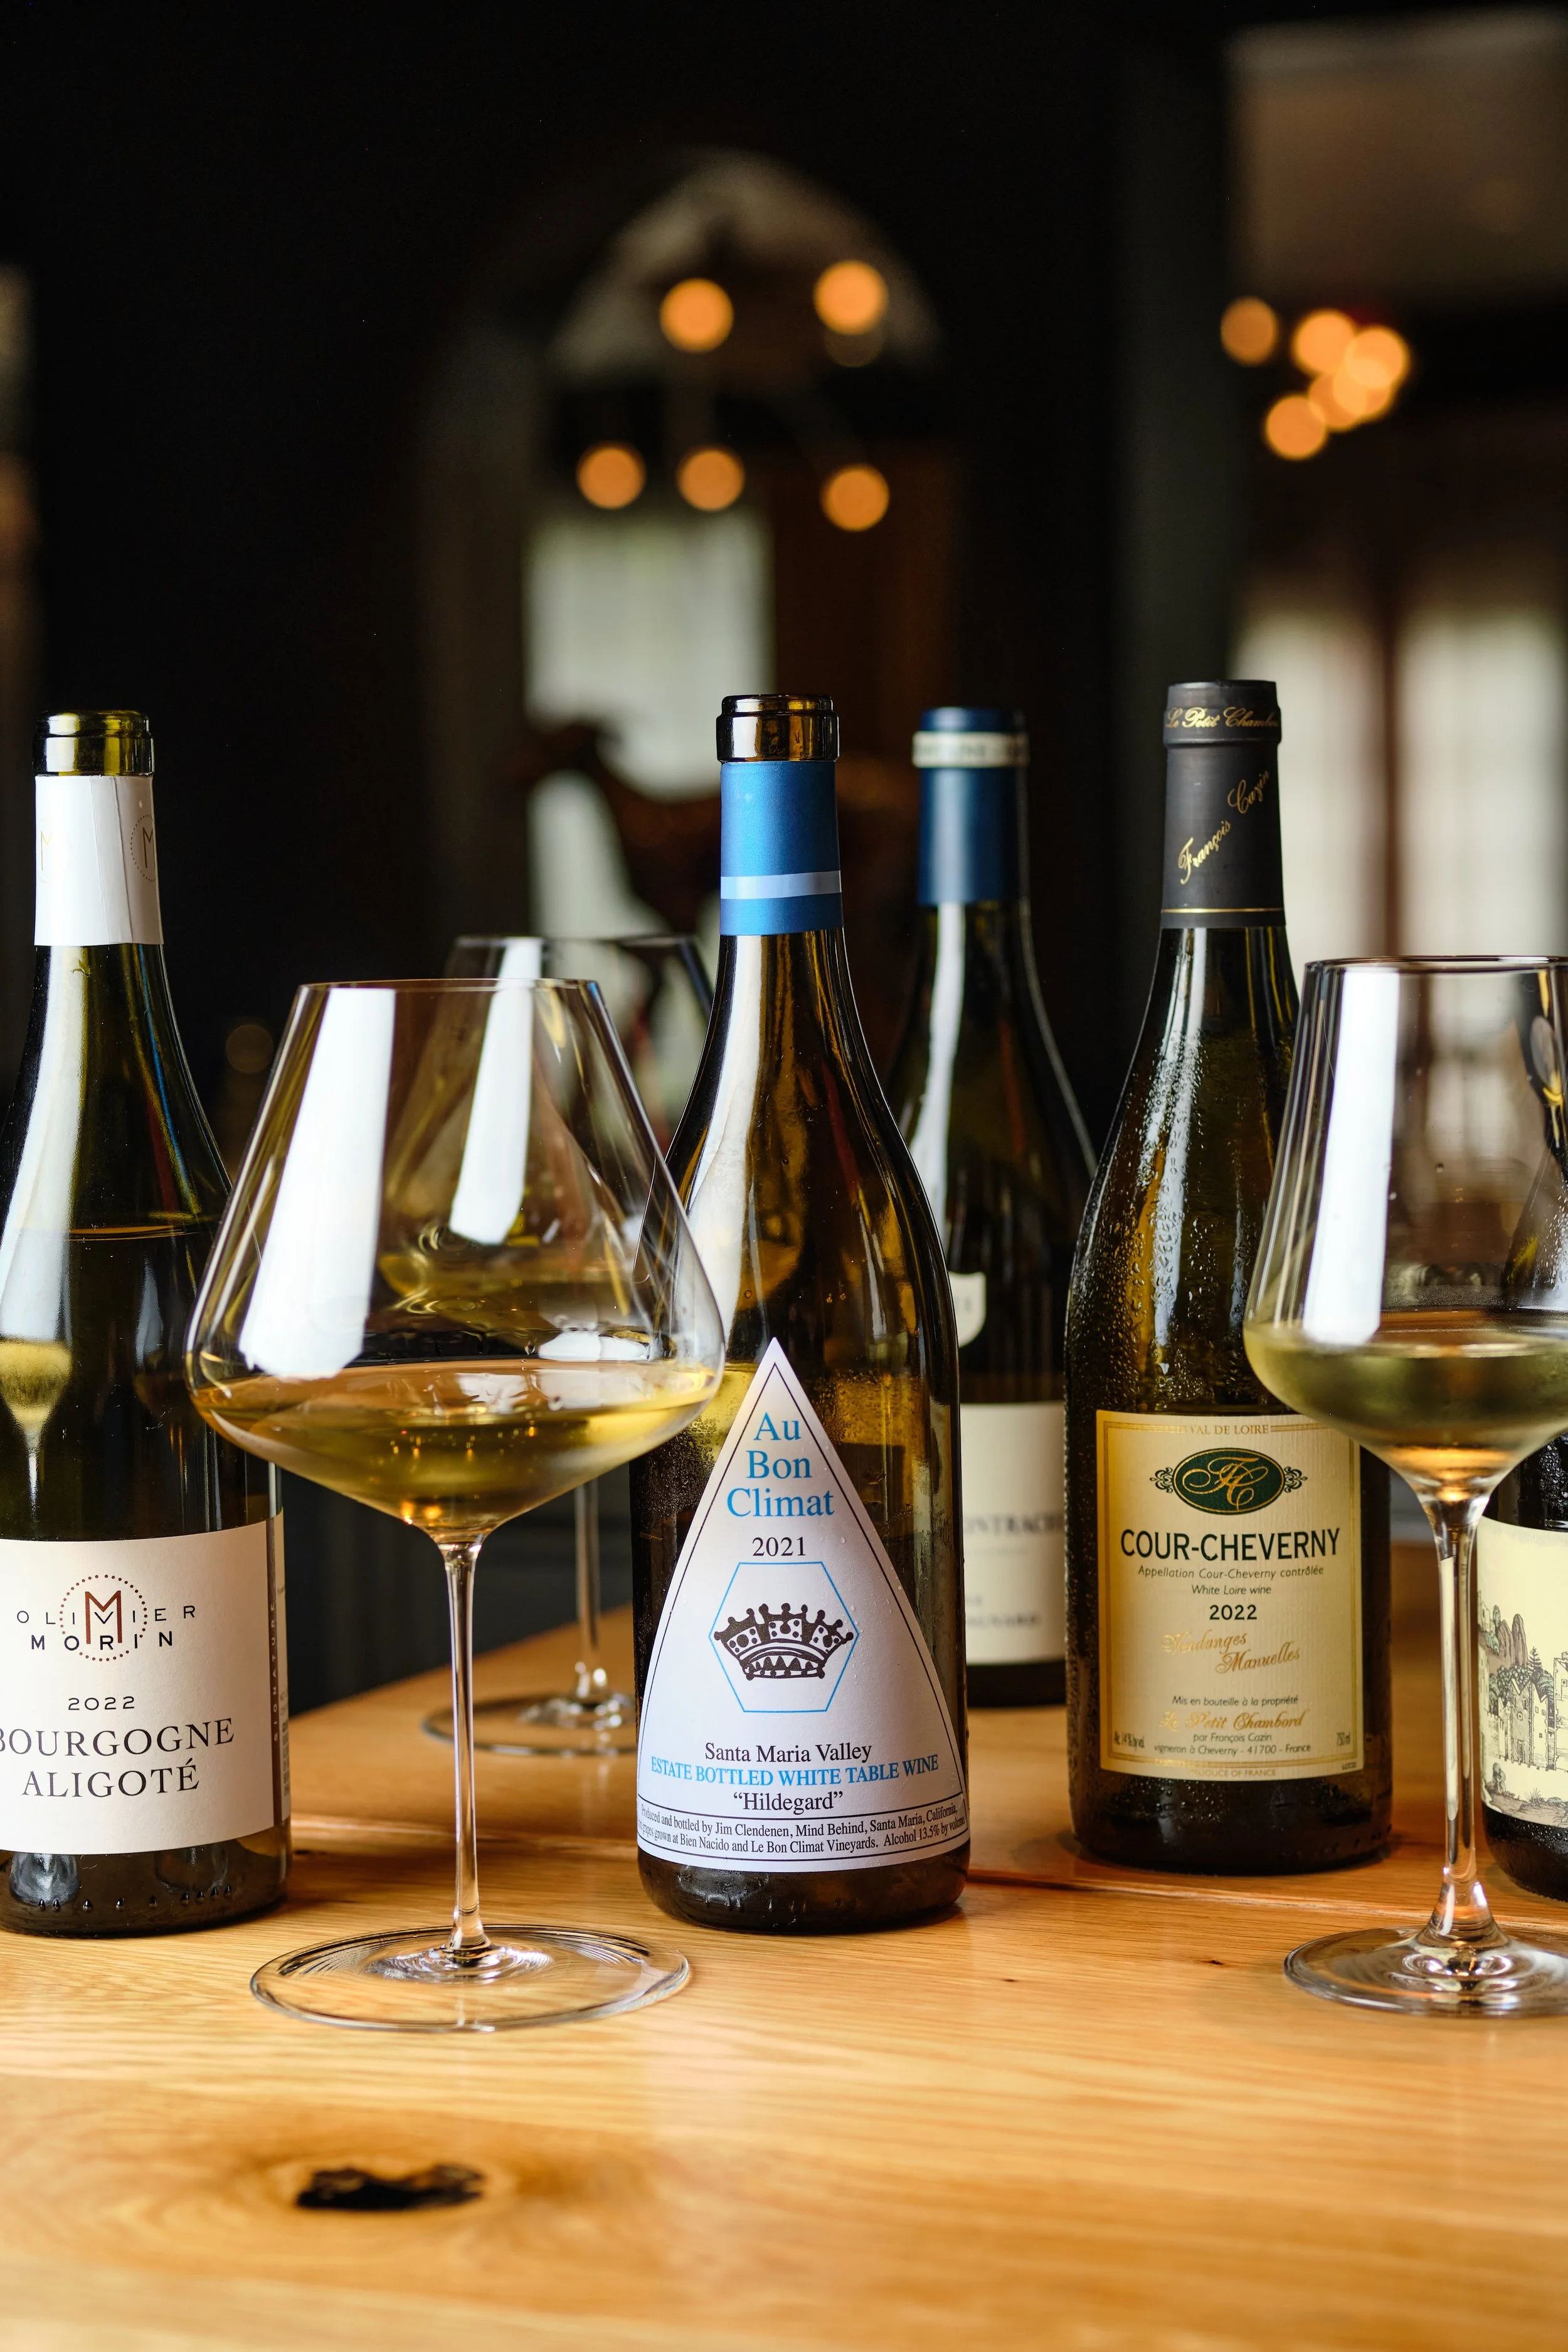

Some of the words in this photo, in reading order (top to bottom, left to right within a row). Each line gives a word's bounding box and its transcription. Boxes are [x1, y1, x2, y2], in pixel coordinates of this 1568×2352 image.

[1165, 707, 1182, 728] Le
[1182, 707, 1220, 728] Petit
[1178, 820, 1231, 884] François
[753, 1412, 801, 1441] Au
[1190, 1425, 1210, 1434] VAL
[1214, 1425, 1230, 1434] DE
[1234, 1424, 1268, 1434] LOIRE
[746, 1450, 812, 1478] Bon
[727, 1488, 835, 1518] Climat
[752, 1537, 806, 1557] 2021
[1121, 1528, 1340, 1561] COUR-CHEVERNY
[1138, 1565, 1194, 1579] Appellation
[1199, 1568, 1276, 1581] Cour-Cheverny
[1280, 1565, 1323, 1577] contrôlée
[1192, 1584, 1219, 1594] White
[1224, 1585, 1246, 1594] Loire
[1250, 1586, 1271, 1594] wine
[1209, 1604, 1257, 1620] 2022
[31, 1631, 172, 1651] MORIN
[1215, 1641, 1301, 1674] Manuelles
[68, 1696, 135, 1710] 2022
[1172, 1695, 1187, 1705] Mis
[1204, 1697, 1239, 1706] bouteille
[1242, 1697, 1248, 1706] à
[1251, 1697, 1258, 1706] la
[1261, 1695, 1298, 1707] propriété
[1185, 1711, 1227, 1729] Petit
[1233, 1708, 1310, 1730] Chambord
[1193, 1734, 1208, 1743] par
[1210, 1733, 1245, 1743] François
[1248, 1732, 1272, 1742] Cazin
[705, 1742, 751, 1762] Santa
[756, 1745, 811, 1762] Maria
[815, 1742, 872, 1763] Valley
[1154, 1745, 1186, 1754] vigneron
[1190, 1745, 1195, 1754] à
[1198, 1745, 1238, 1757] Cheverny
[1286, 1744, 1311, 1753] France
[21, 1758, 199, 1798] ALIGOTÉ
[651, 1756, 692, 1780] ESTATE
[696, 1766, 773, 1786] BOTTLED
[778, 1769, 842, 1786] WHITE
[845, 1762, 899, 1783] TABLE
[903, 1754, 939, 1776] WINE
[733, 1791, 843, 1815] “Hildegard”
[642, 1804, 660, 1823] Produced
[662, 1815, 672, 1826] and
[674, 1816, 699, 1831] bottled
[702, 1821, 712, 1836] by
[716, 1822, 733, 1835] Jim
[735, 1823, 793, 1838] Clendenen,
[795, 1824, 824, 1836] Mind
[827, 1820, 867, 1835] Behind,
[870, 1820, 896, 1832] Santa
[898, 1813, 925, 1828] Maria,
[926, 1803, 958, 1822] California,
[655, 1830, 671, 1842] grown
[672, 1835, 679, 1844] at
[680, 1833, 697, 1847] Bien
[699, 1836, 729, 1851] Nacido
[732, 1840, 748, 1852] and
[751, 1841, 764, 1852] Le
[766, 1841, 787, 1853] Bon
[790, 1841, 824, 1853] Climat
[827, 1836, 878, 1853] Vineyards.
[883, 1830, 916, 1846] Alcohol
[919, 1824, 940, 1840] 13.5%
[941, 1821, 948, 1836] by
